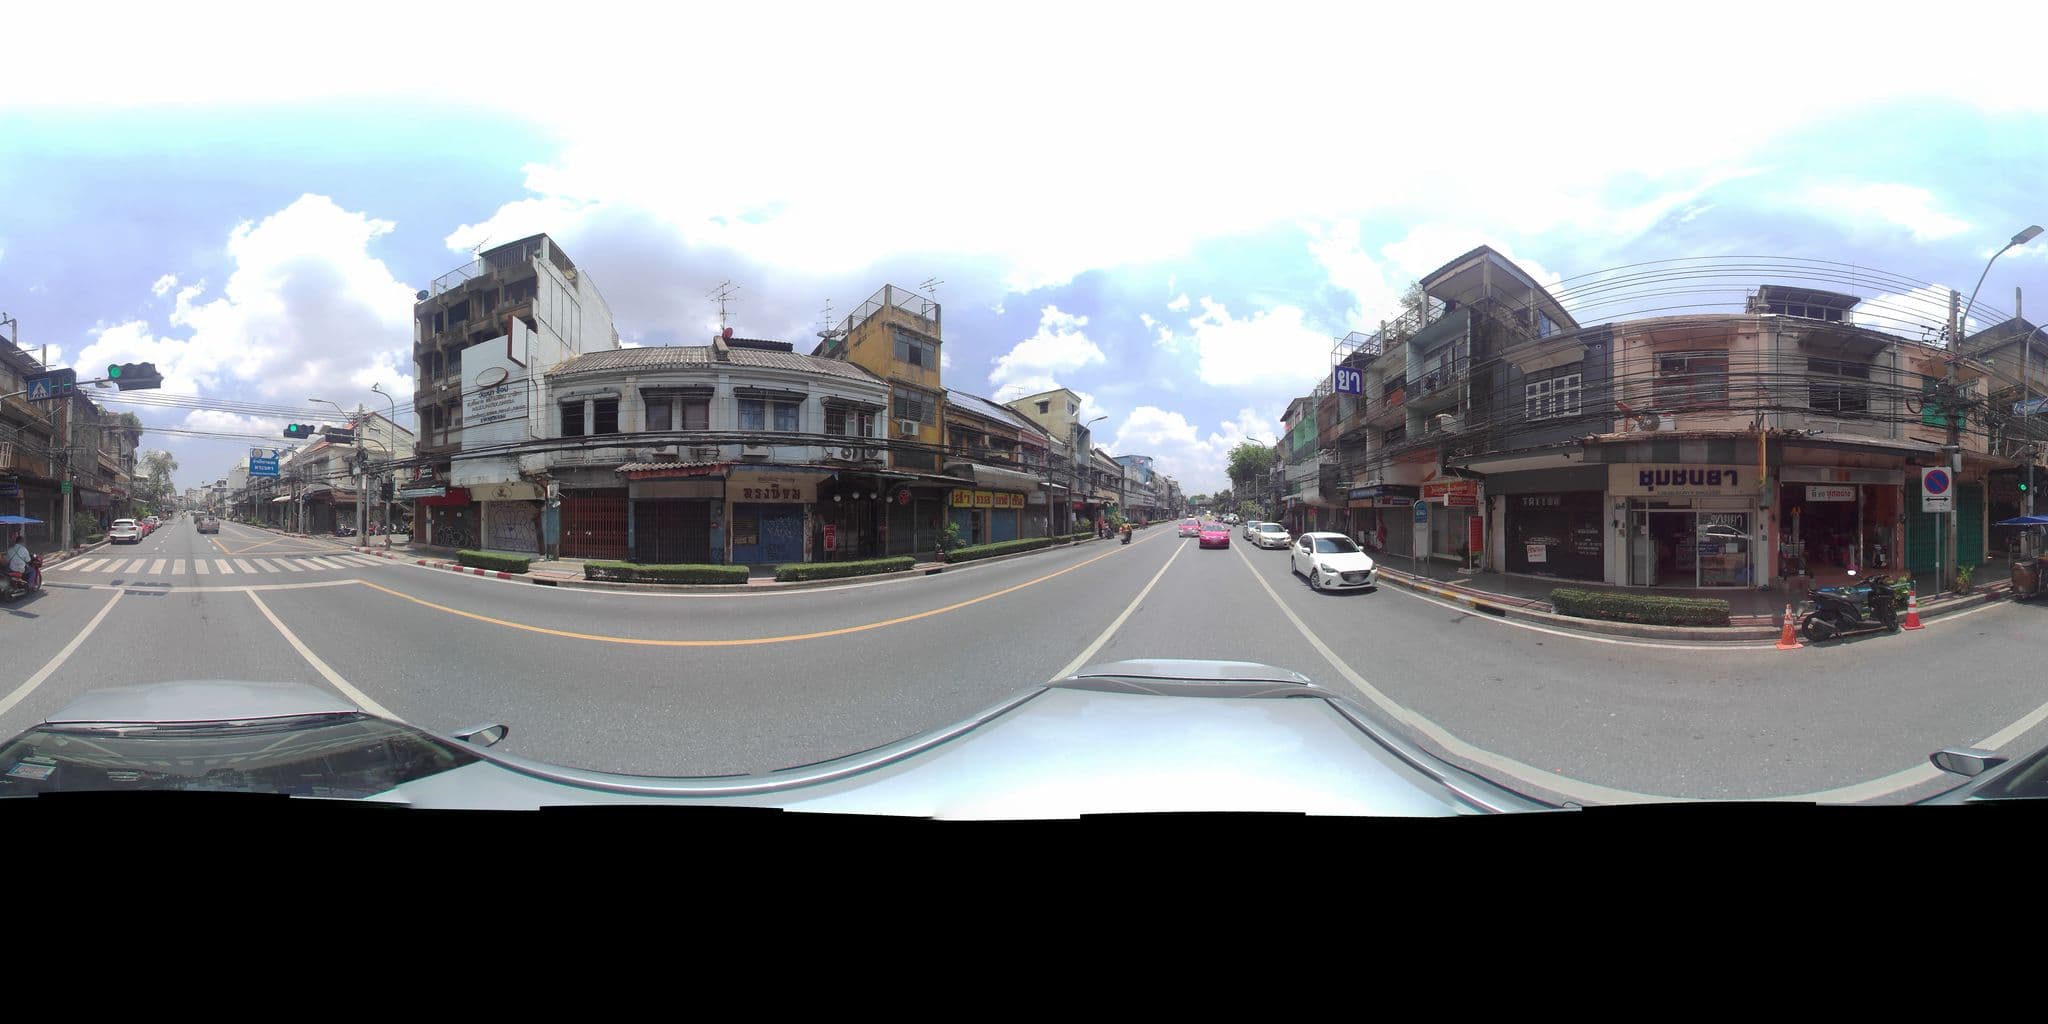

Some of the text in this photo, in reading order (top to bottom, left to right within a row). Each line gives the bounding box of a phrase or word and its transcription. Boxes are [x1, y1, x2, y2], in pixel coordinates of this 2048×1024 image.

[1338, 370, 1360, 392] ยา
[1639, 469, 1738, 492] ชุมชนยา
